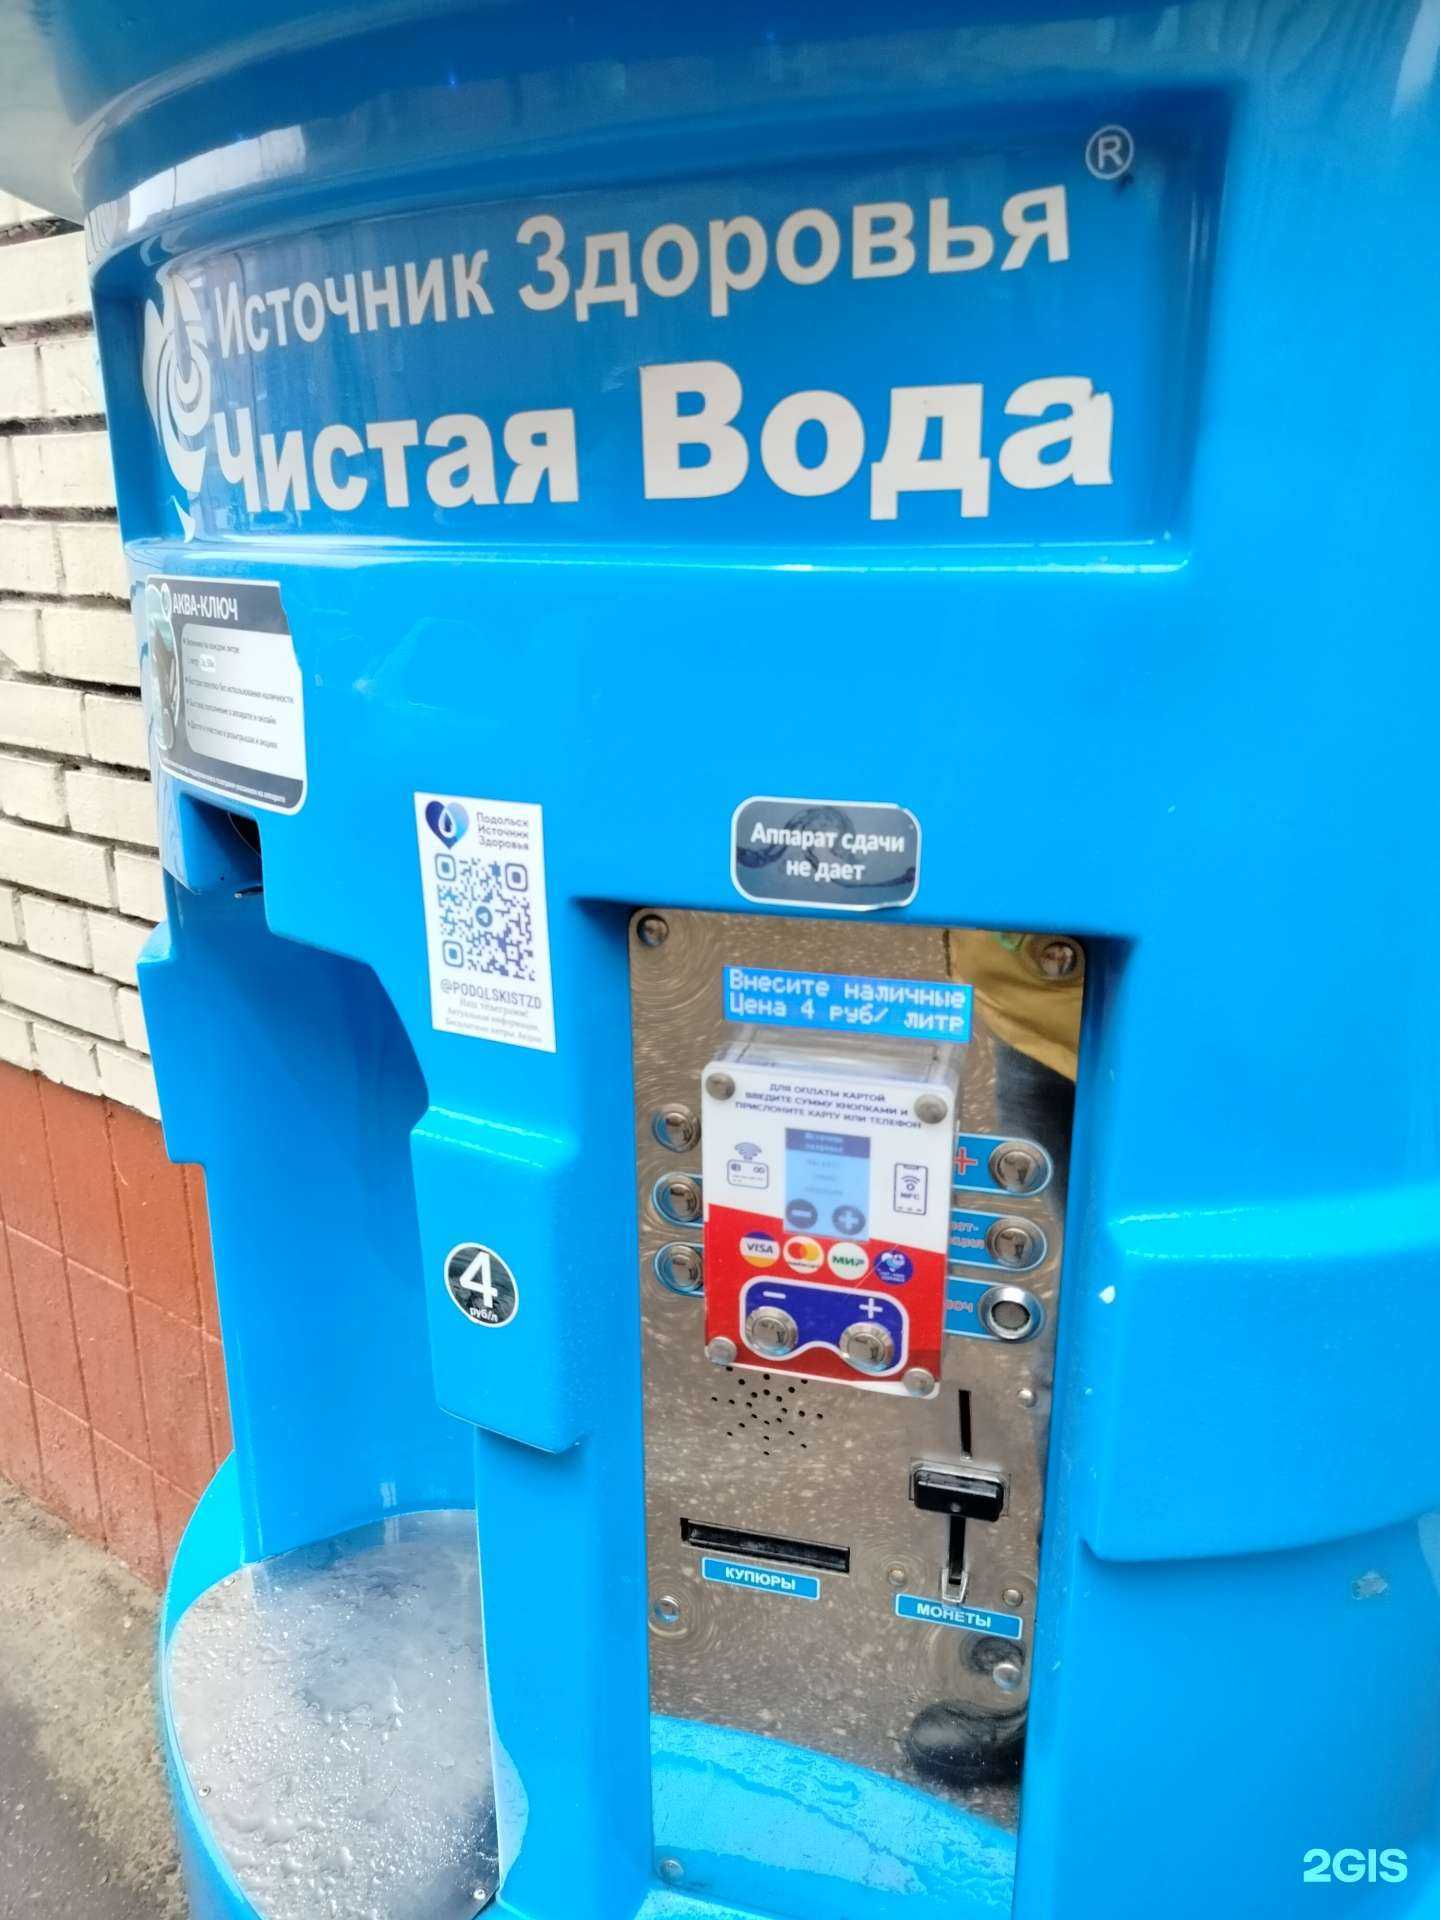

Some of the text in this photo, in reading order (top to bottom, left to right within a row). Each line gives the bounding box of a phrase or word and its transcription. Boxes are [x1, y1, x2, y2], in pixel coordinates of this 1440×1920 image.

[213, 185, 1072, 360] Источник Здоровья
[213, 360, 1114, 521] Чистая Вода
[173, 592, 239, 621] АКВА-КЛЮЧ
[476, 811, 529, 828] Подольск
[478, 825, 529, 839] Источник
[480, 835, 529, 851] Здоровья
[750, 822, 906, 855] Аппарат сдачи
[786, 860, 866, 883] не дает
[729, 968, 967, 1009] Внесите наличные
[729, 991, 788, 1018] Цена
[800, 1000, 815, 1020] 4
[904, 1012, 965, 1033] литр
[745, 1092, 792, 1103] ВВЕДИТЕ
[795, 1097, 833, 1108] СУММУ
[836, 1102, 897, 1115] КНОПКАМИ
[769, 1083, 886, 1102] ДЛЯ ОПЛАТЫ КАРТОЙ
[735, 1101, 922, 1129] ПРИСЛОНИТЕ КАРТУ ИЛИ ТЕЛЕФОН
[745, 1243, 775, 1254] VISA
[831, 1256, 866, 1267] МИР
[460, 1251, 498, 1308] 4
[469, 1306, 499, 1323] руб/л
[725, 1566, 797, 1592] КУПЮРЫ
[916, 1602, 993, 1629] МОНЕТЫ
